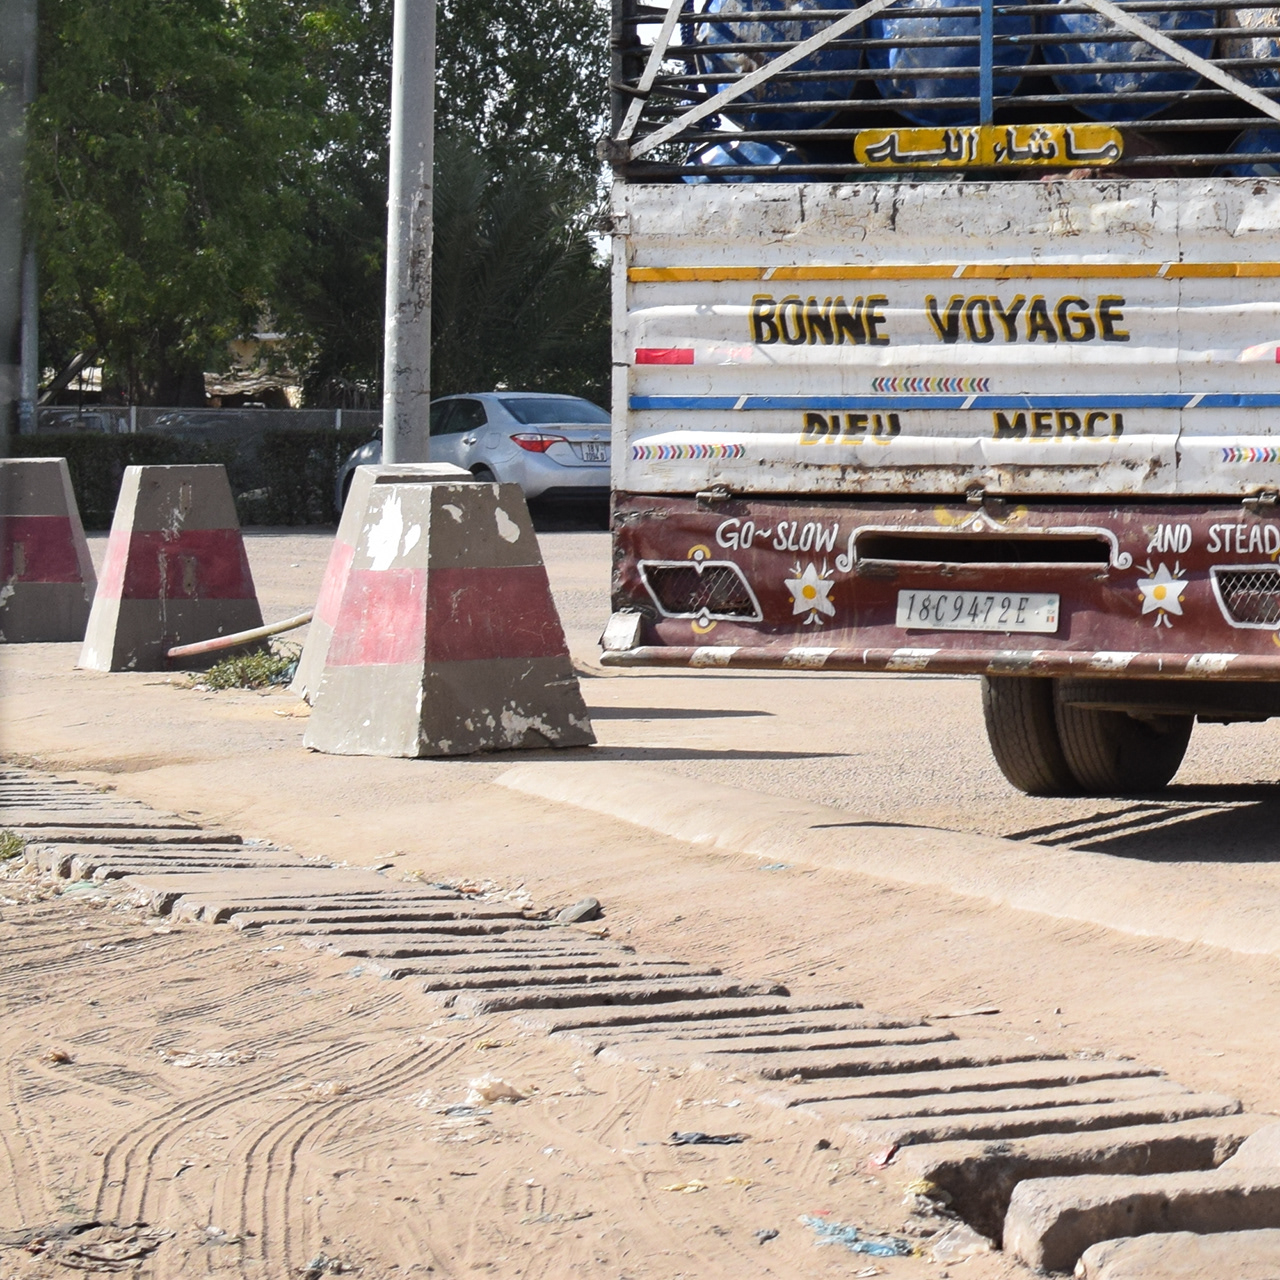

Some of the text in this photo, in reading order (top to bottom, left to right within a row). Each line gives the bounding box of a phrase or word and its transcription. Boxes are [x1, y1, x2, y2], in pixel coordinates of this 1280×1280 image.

[865, 129, 978, 162] الله
[1065, 126, 1120, 161] ما
[749, 294, 1130, 345] BONNE VOYAGE
[799, 411, 1124, 446] DIEU MERCI
[1147, 523, 1192, 553] AND
